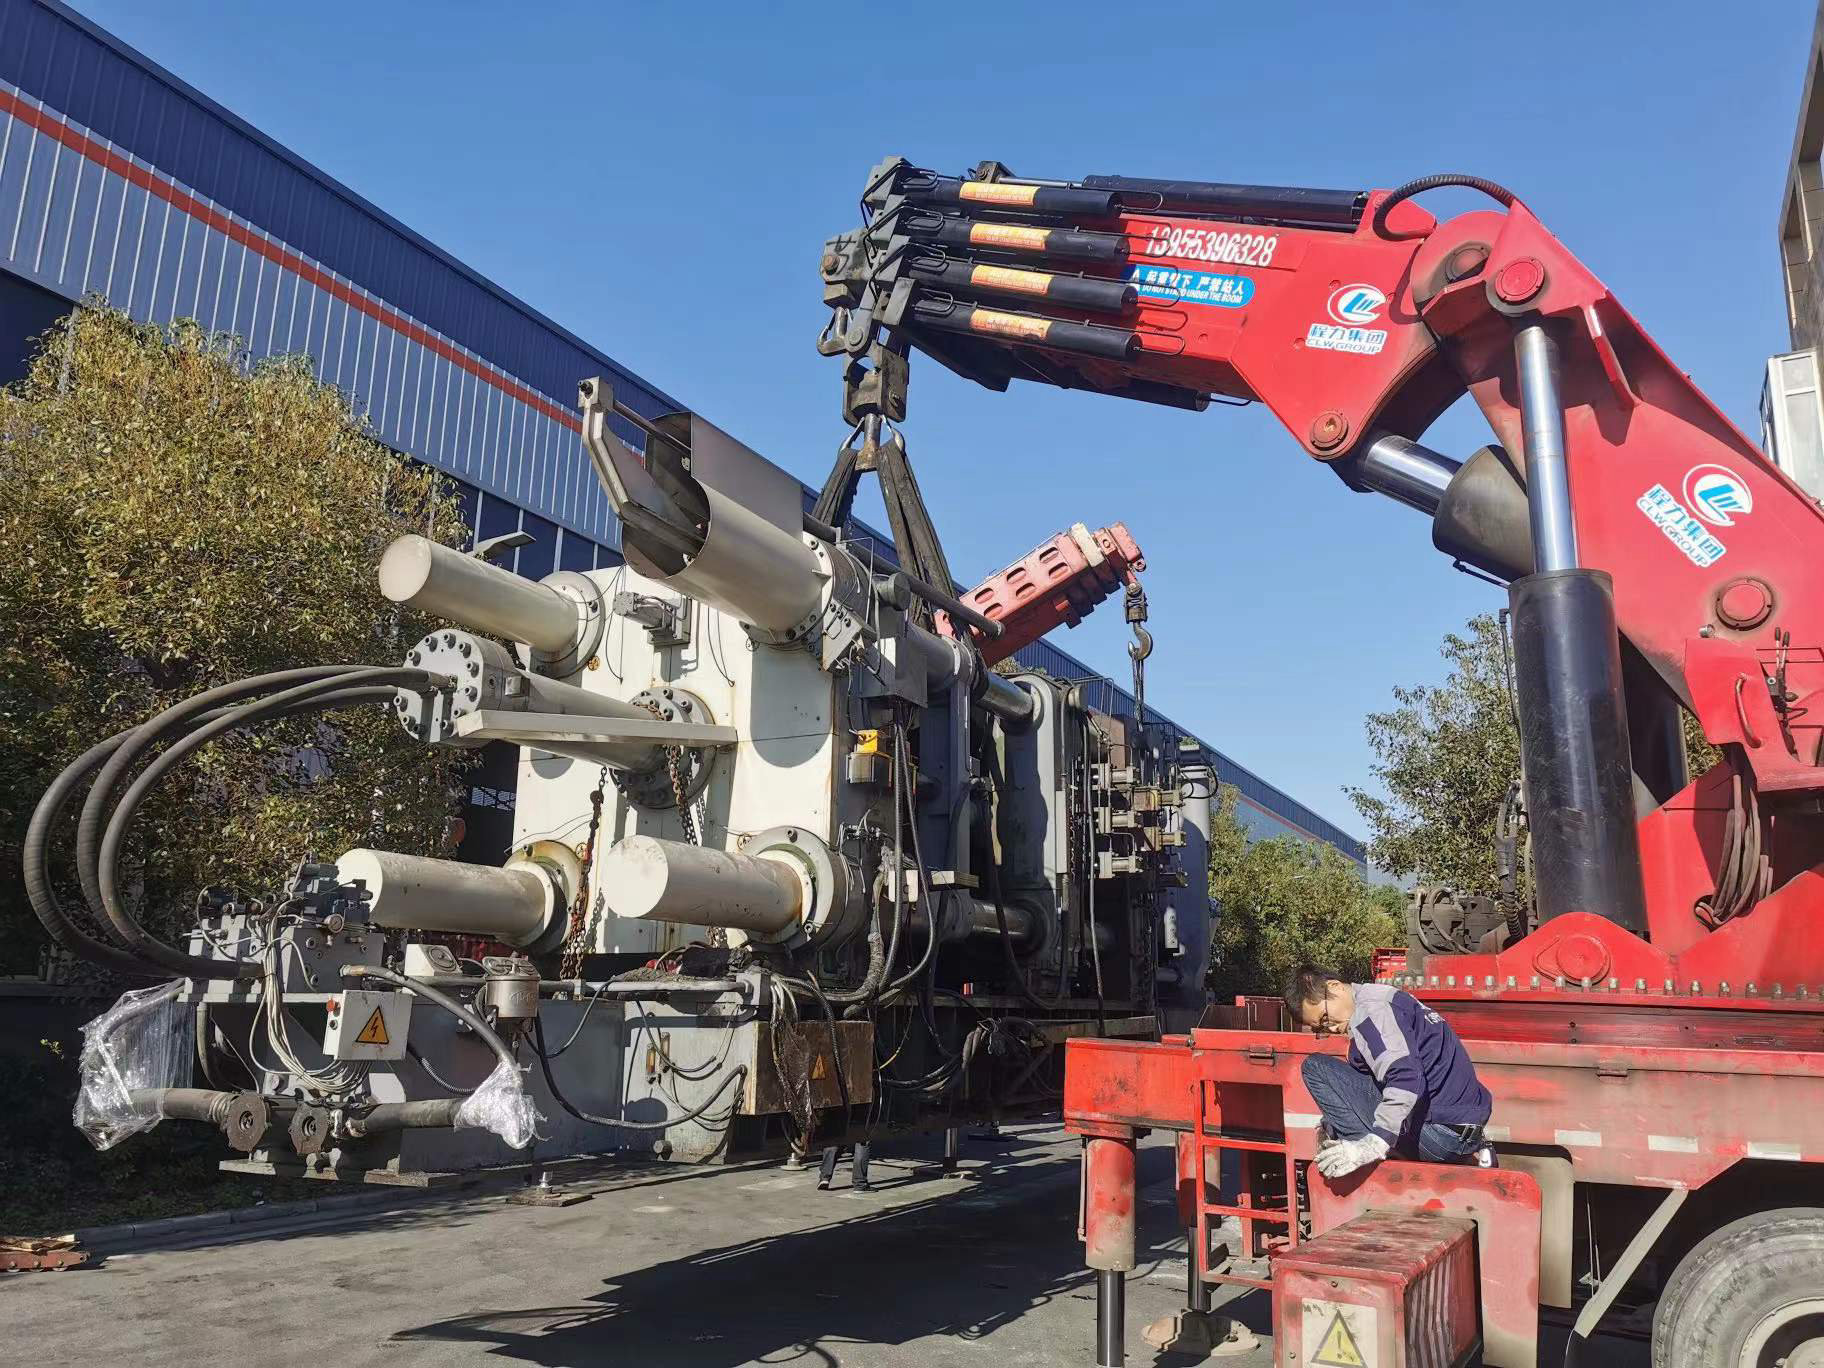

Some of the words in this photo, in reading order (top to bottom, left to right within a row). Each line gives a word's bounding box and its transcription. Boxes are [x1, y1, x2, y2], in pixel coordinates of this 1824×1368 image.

[1146, 226, 1277, 266] 13955396328
[1310, 325, 1385, 344] 程力集团
[1648, 487, 1724, 560] 程力集团
